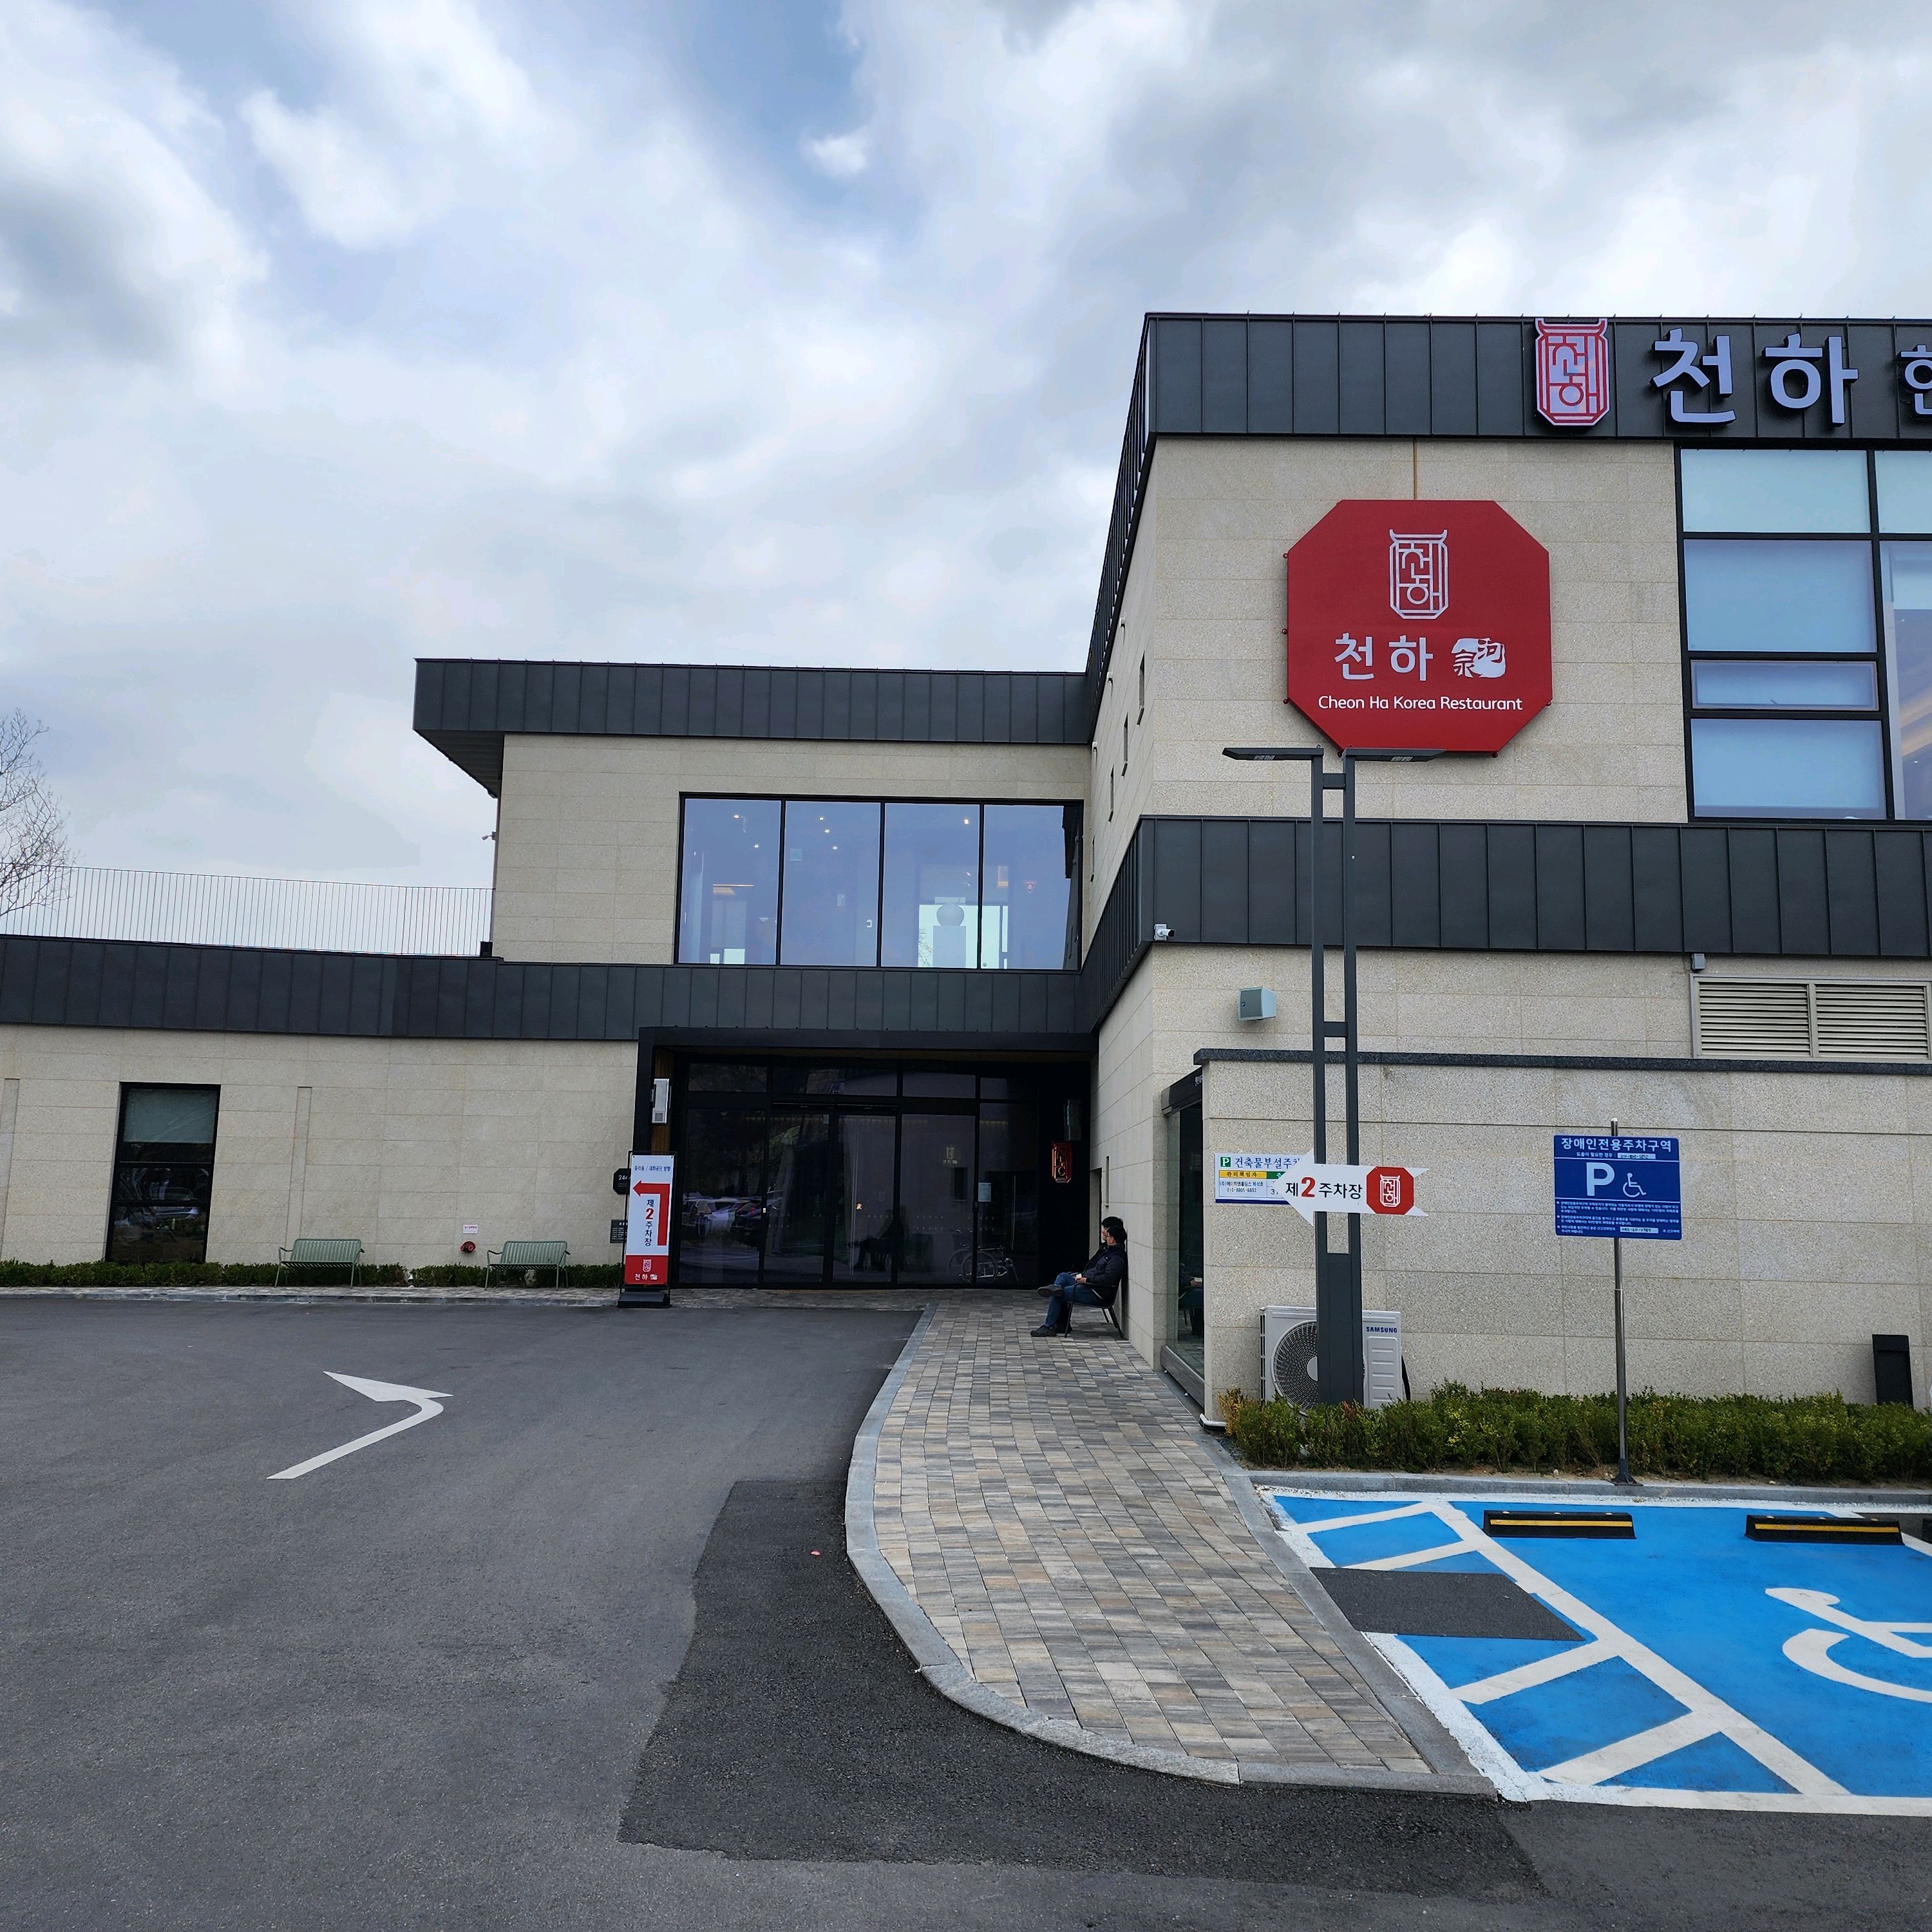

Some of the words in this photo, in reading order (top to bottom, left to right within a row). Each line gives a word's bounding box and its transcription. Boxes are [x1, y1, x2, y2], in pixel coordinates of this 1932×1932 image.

[1318, 696, 1365, 709] Cheon
[1370, 696, 1388, 709] Ha
[1394, 696, 1435, 710] Korea
[1440, 696, 1523, 710] Restaurant
[1561, 1137, 1672, 1152] 장애인전용주차구역
[1586, 1162, 1615, 1197] P
